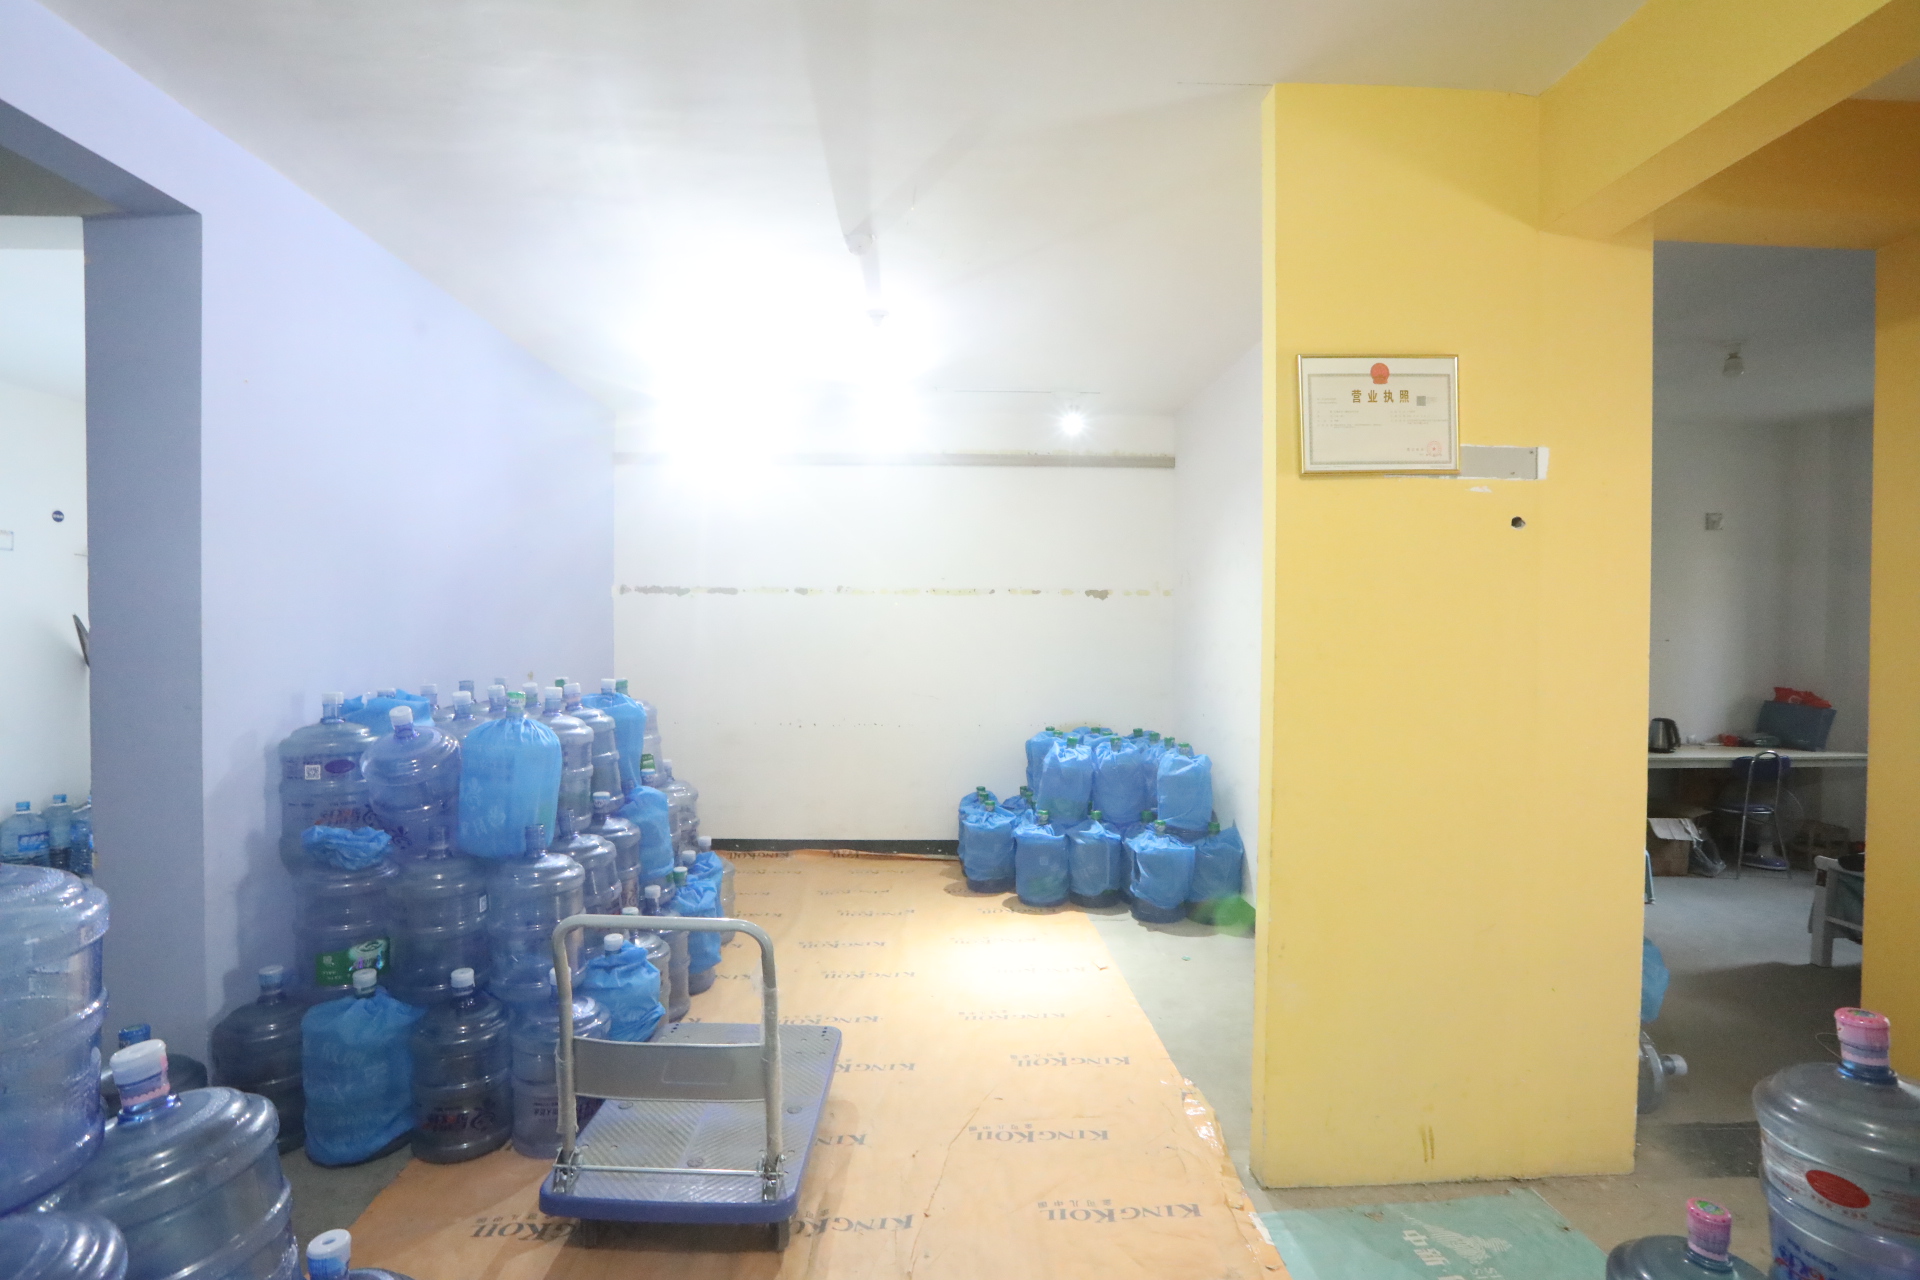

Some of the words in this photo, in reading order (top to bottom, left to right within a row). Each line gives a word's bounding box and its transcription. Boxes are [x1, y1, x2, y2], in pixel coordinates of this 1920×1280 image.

[1351, 389, 1410, 403] 营业执照
[834, 1062, 917, 1073] KINGK
[1013, 1056, 1131, 1068] KINGKOIL
[969, 1129, 1109, 1143] KINGKOIL
[1039, 1203, 1203, 1223] KINGKOIL
